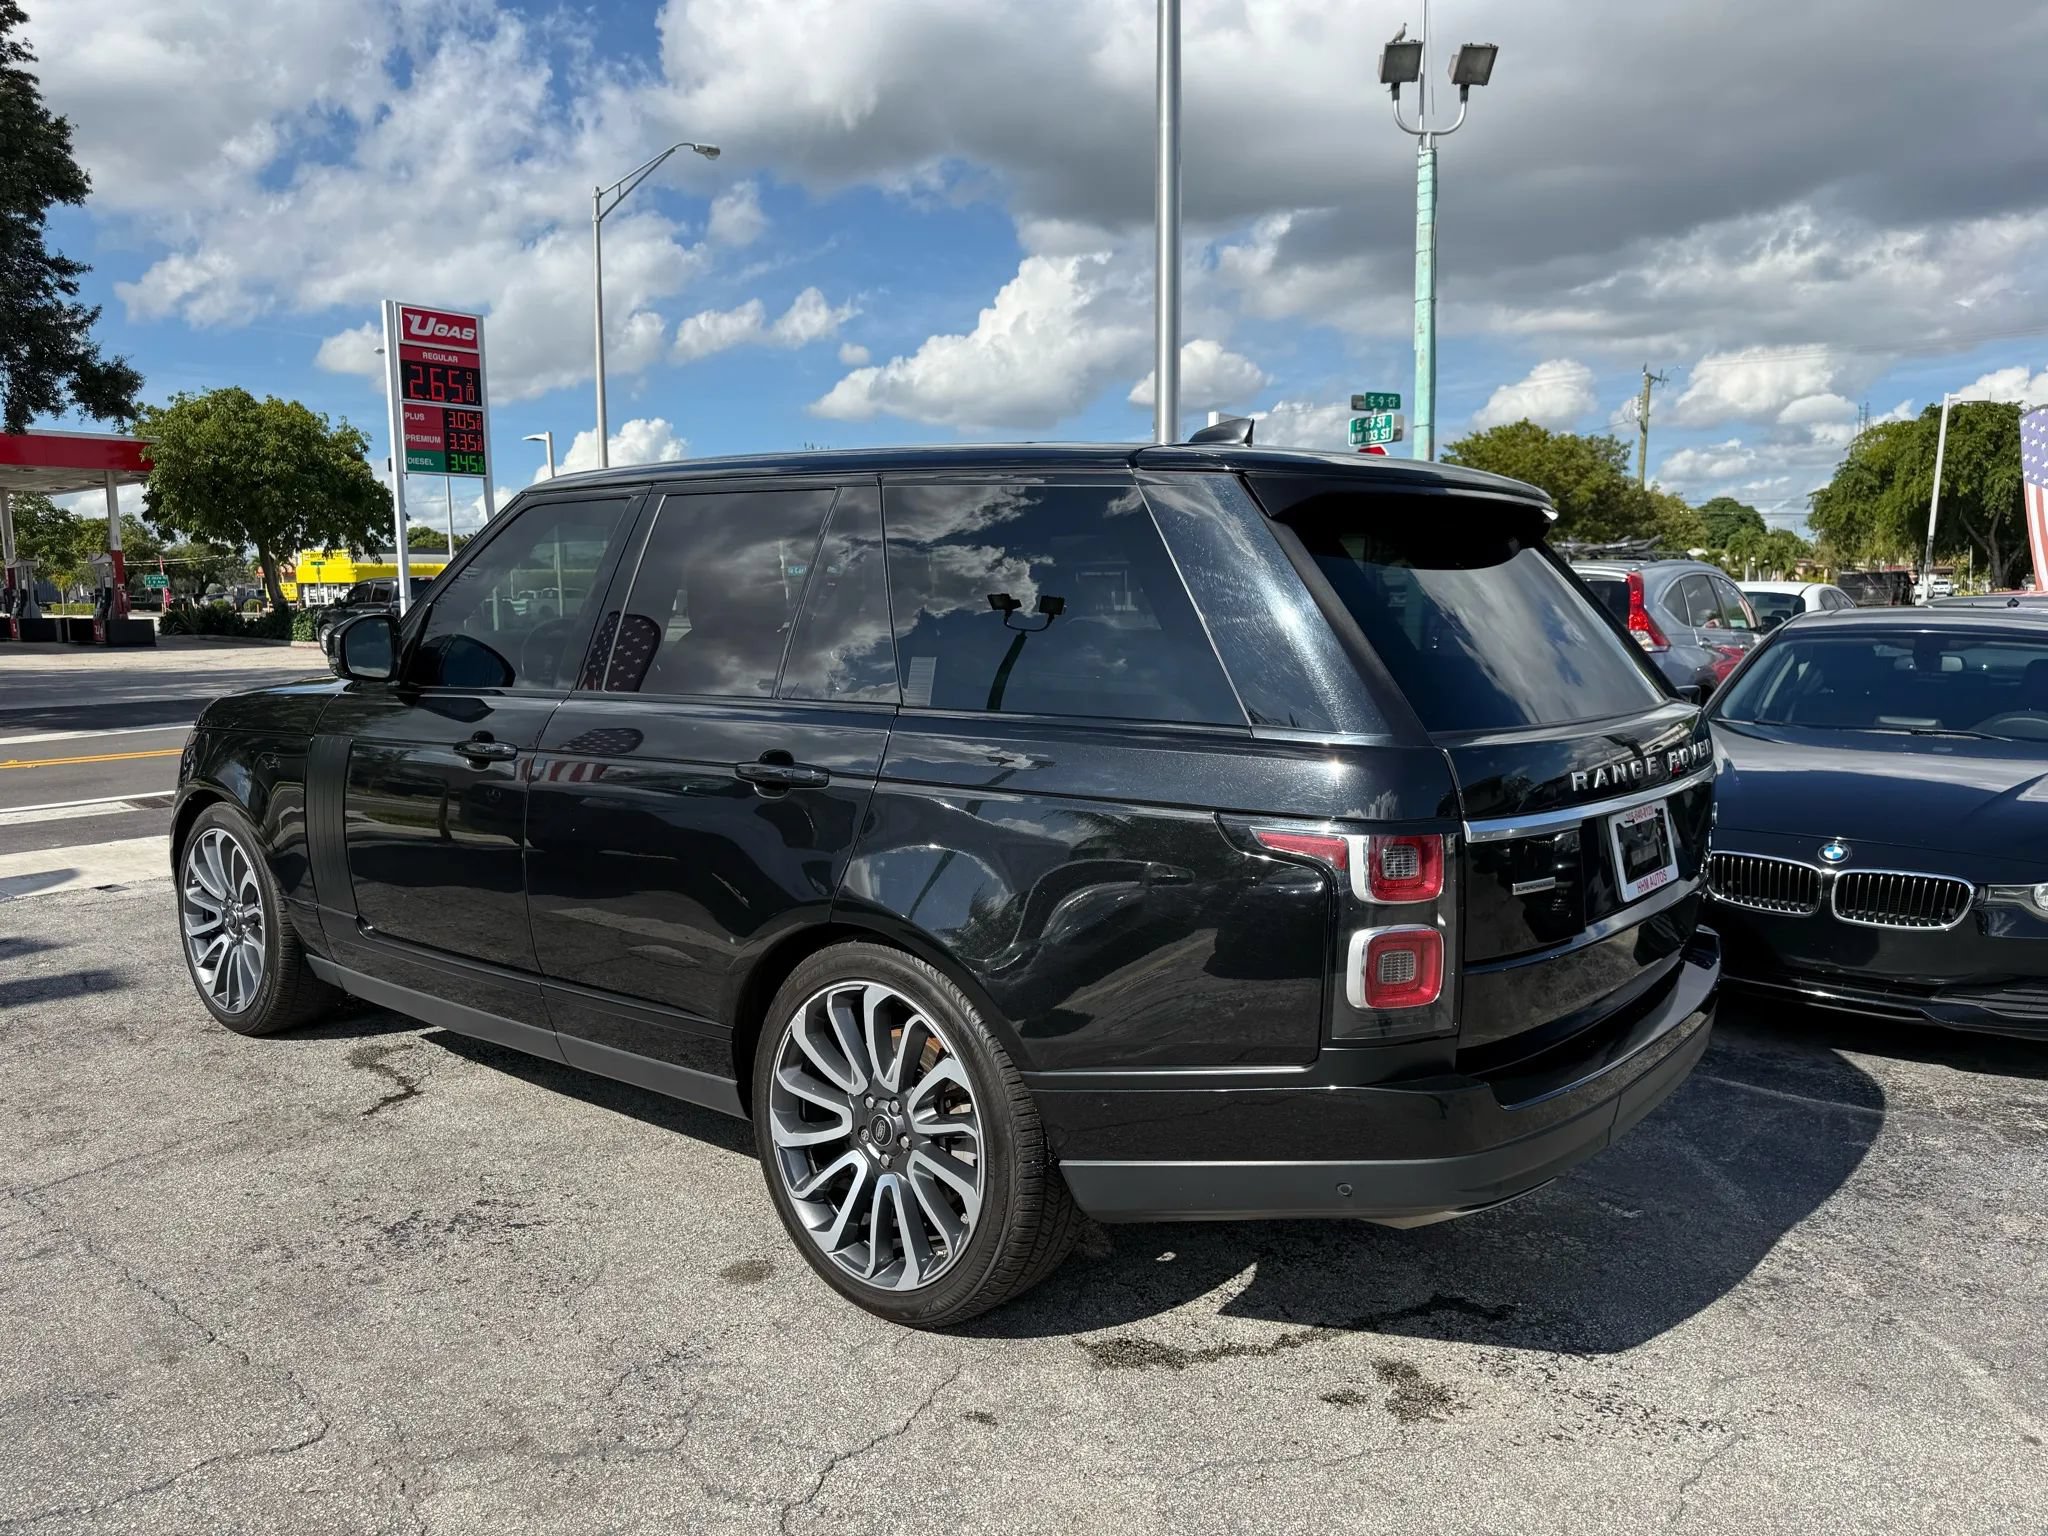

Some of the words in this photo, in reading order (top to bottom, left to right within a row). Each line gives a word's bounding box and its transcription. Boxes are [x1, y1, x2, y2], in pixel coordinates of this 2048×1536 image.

[422, 352, 459, 363] REGULAR
[409, 365, 464, 403] 2.65
[404, 412, 425, 421] PLUS
[1377, 416, 1386, 427] ST
[405, 434, 441, 444] PREMIUM
[1380, 428, 1390, 439] ST
[407, 457, 434, 466] DIESEL
[1571, 756, 1658, 792] RANGE
[1649, 869, 1668, 887] AUTOS
